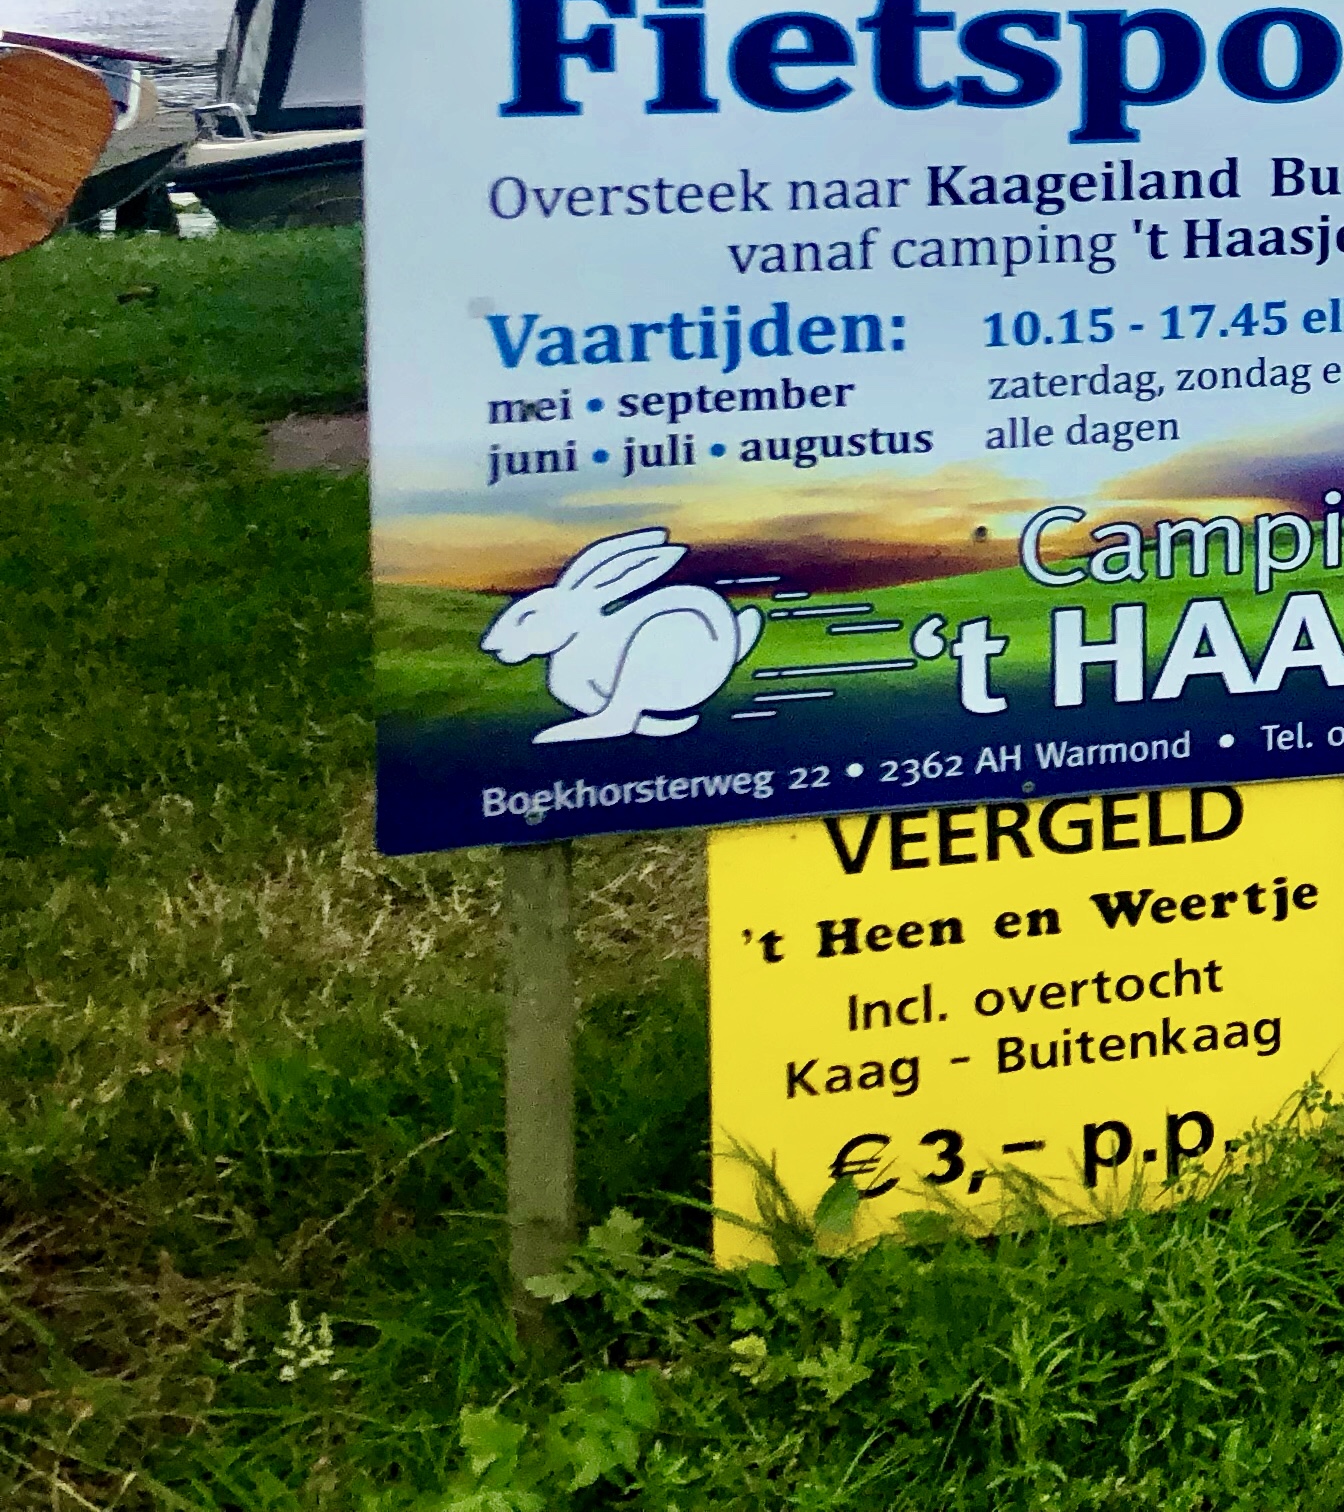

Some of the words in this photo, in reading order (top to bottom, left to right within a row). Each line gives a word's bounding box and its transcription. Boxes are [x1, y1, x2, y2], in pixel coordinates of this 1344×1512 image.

[488, 169, 771, 219] Oversteek
[789, 177, 910, 211] naar
[928, 159, 1240, 214] Kaageiland
[728, 228, 879, 275] vanaf
[894, 224, 1117, 277] camping
[487, 302, 907, 375] Vaartijden:
[983, 306, 1115, 348] 10.15
[1162, 300, 1287, 339] 17.45
[488, 386, 572, 424] mei
[617, 378, 856, 424] september
[988, 365, 1166, 402] zaterdag,
[1175, 357, 1311, 394] zondag
[487, 440, 577, 485] juni
[622, 434, 696, 478] juli
[740, 426, 935, 467] augustus
[985, 416, 1054, 451] alle
[1065, 410, 1181, 451] dagen
[482, 771, 775, 817] Boekhorsterweg
[789, 767, 829, 790] 22
[880, 757, 962, 786] 2362
[975, 745, 1021, 774] AH
[1036, 731, 1191, 770] Warmond
[1262, 723, 1314, 753] Tel.
[825, 786, 1244, 875] VEERGELD
[817, 916, 963, 958] Heen
[994, 903, 1062, 940] en
[1091, 876, 1320, 930] Weertje
[848, 983, 948, 1031] Incl.
[975, 958, 1223, 1017] overtocht
[786, 1051, 921, 1099] Kaag
[997, 1015, 1283, 1074] Buitenkaag
